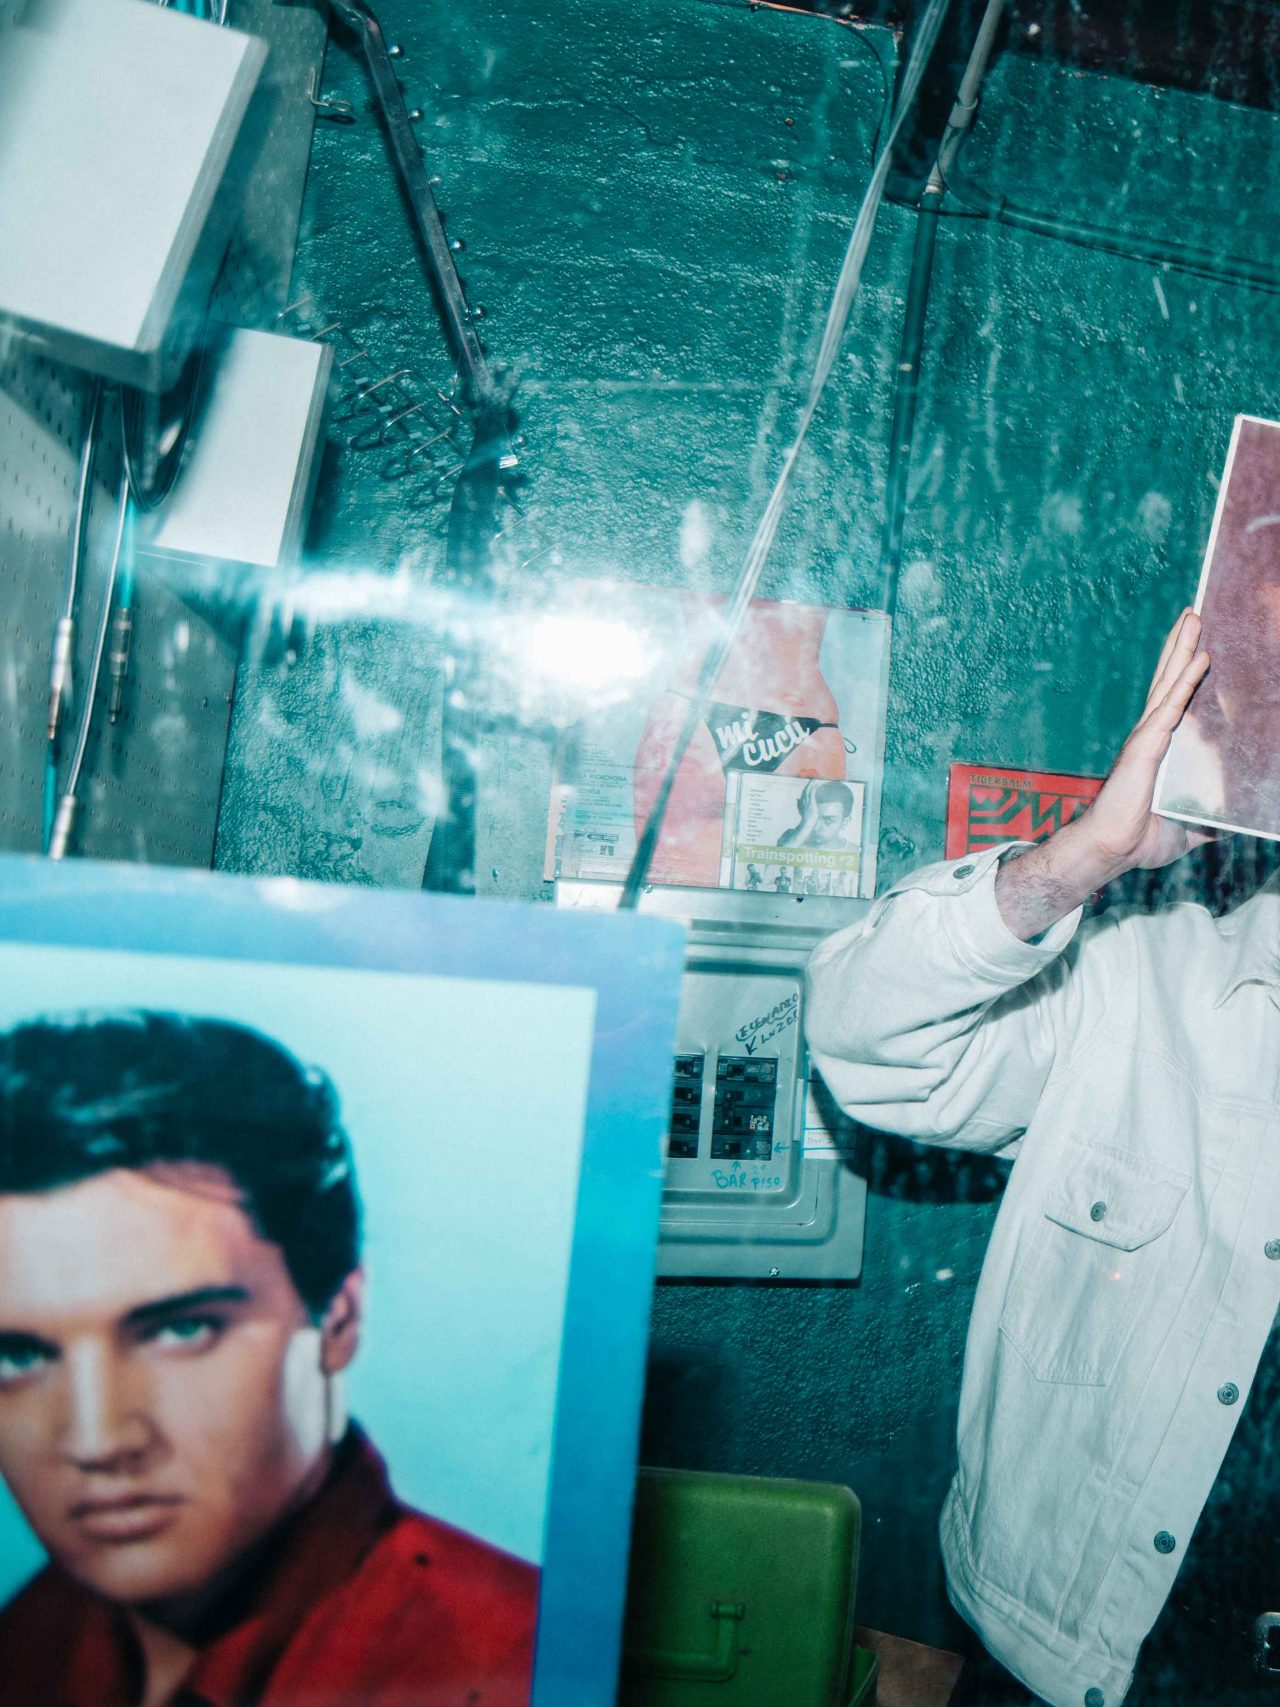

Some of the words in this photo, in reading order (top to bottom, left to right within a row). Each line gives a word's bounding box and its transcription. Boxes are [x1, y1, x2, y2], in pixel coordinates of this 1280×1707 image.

[716, 712, 759, 749] mi
[970, 774, 1032, 790] TIGERBALM
[744, 847, 836, 868] Trainspotting
[711, 1169, 747, 1189] BAR
